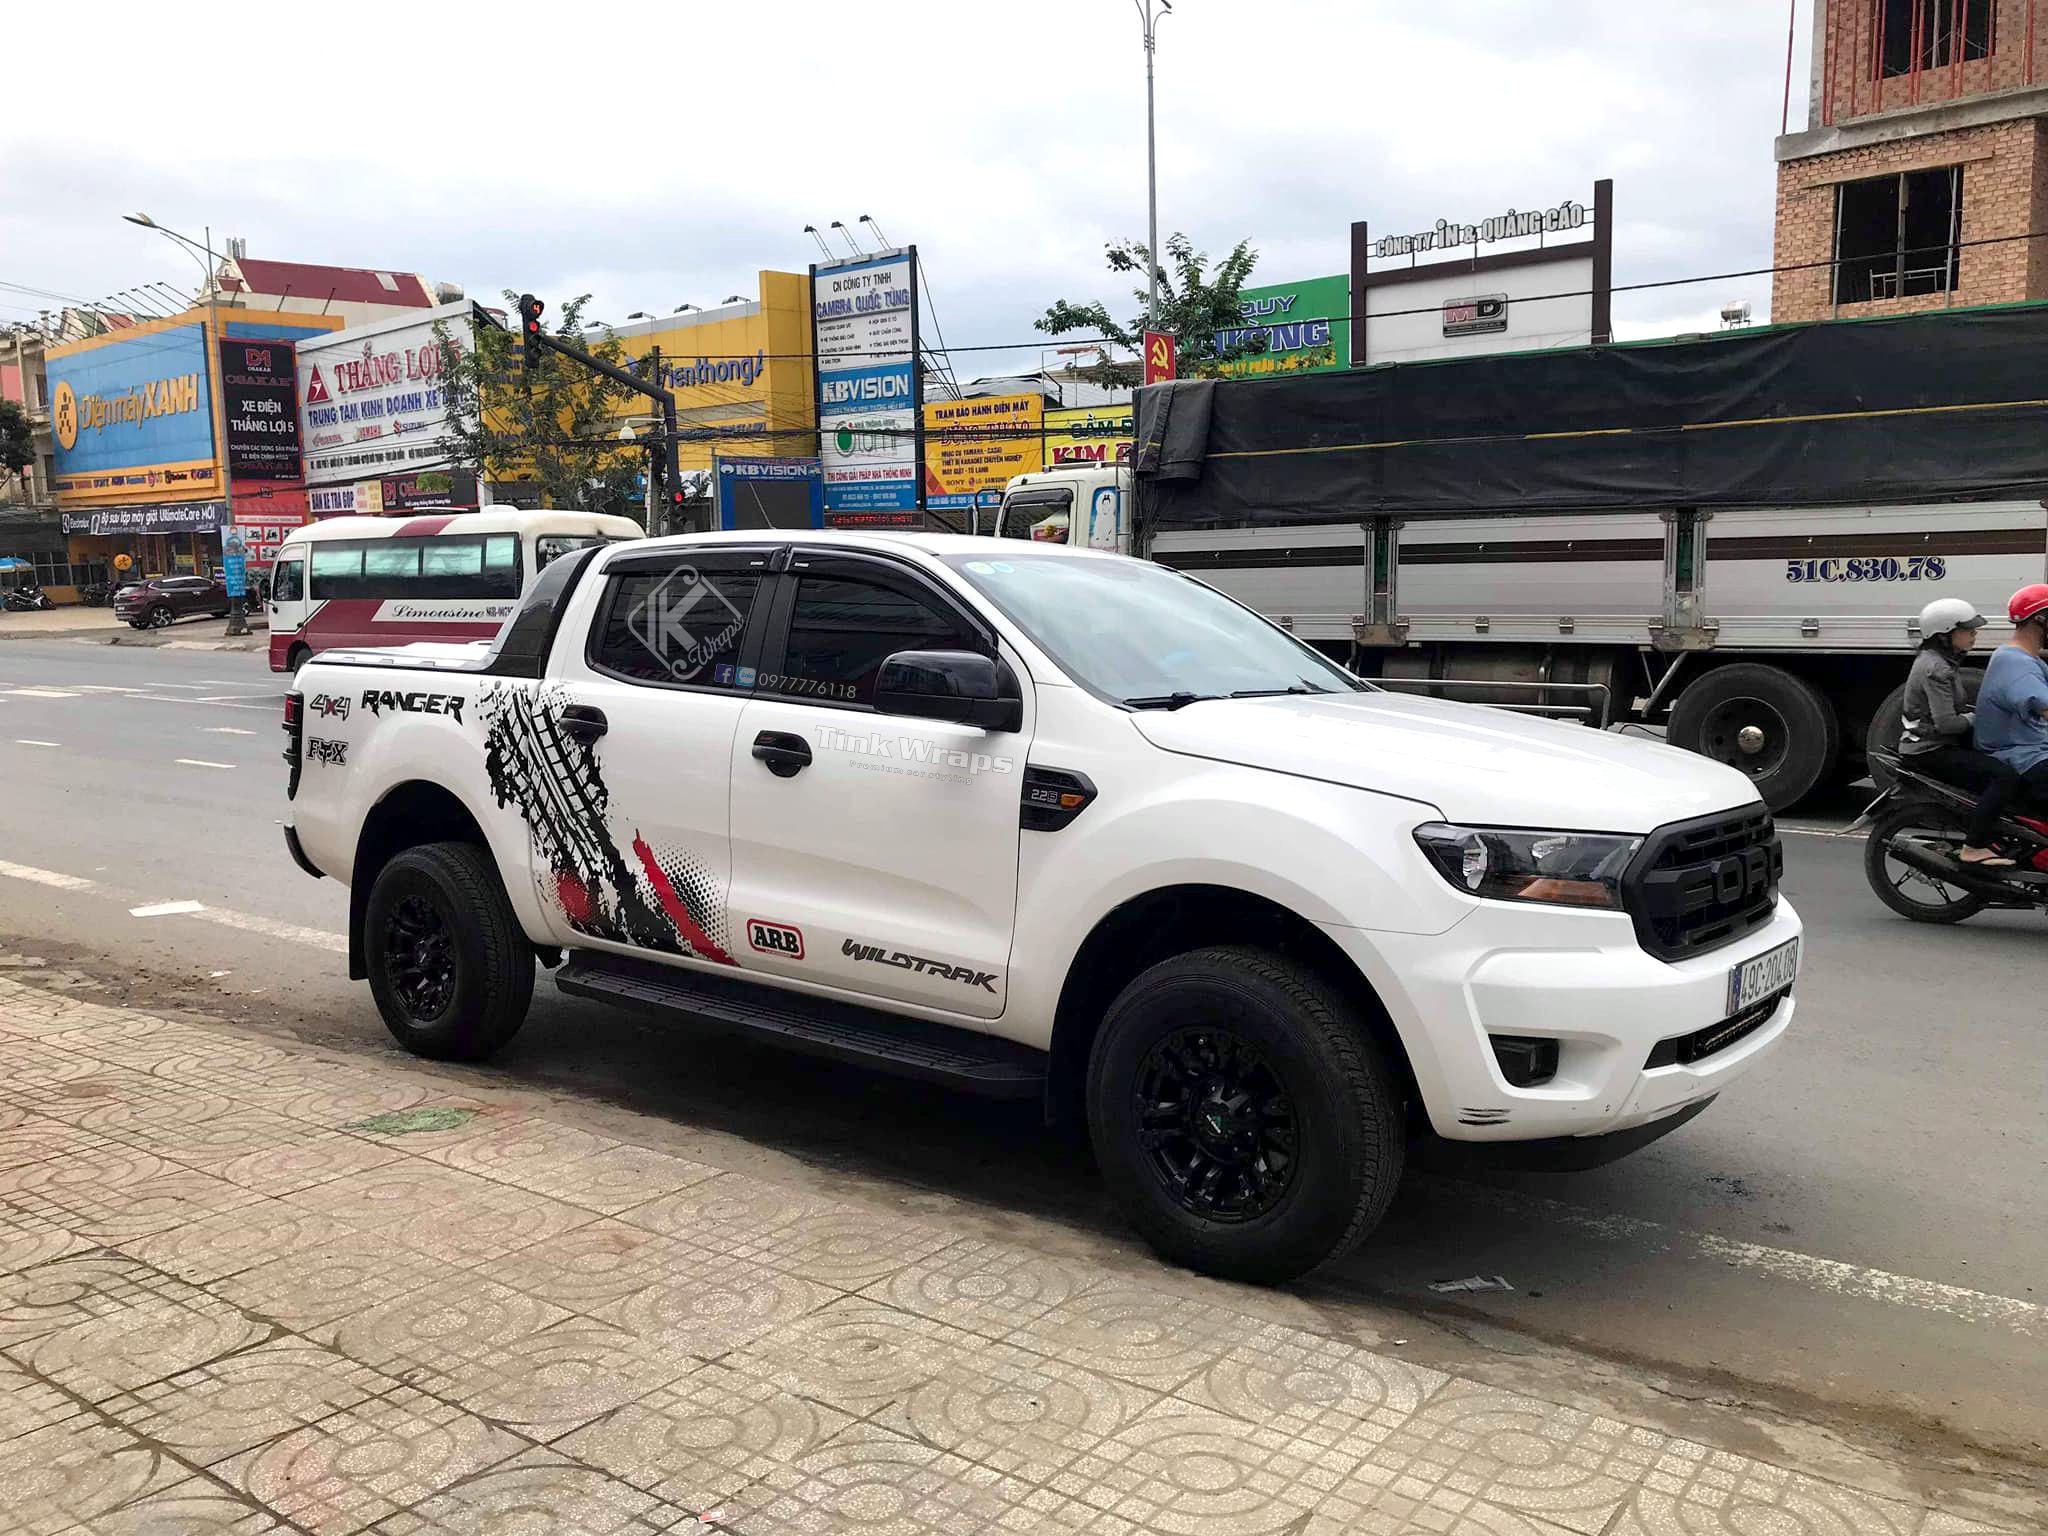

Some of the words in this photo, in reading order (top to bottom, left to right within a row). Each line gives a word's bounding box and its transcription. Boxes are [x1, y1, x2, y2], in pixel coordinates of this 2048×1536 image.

[1376, 235, 1413, 258] CÔNG
[1414, 232, 1433, 251] TY
[1463, 225, 1476, 244] &
[1481, 209, 1542, 243] QUẢNG
[1544, 201, 1585, 232] CÁO
[833, 281, 841, 292] CN
[843, 277, 860, 291] CÔNG
[862, 275, 872, 287] TY
[874, 272, 891, 285] TNHH
[856, 288, 882, 312] QUỐC
[884, 287, 910, 308] TÙNG
[334, 341, 401, 393] THẮNG
[405, 339, 444, 386] LỢI
[145, 373, 199, 418] XANH
[822, 374, 909, 404] KBVISION
[242, 400, 256, 413] XE
[258, 399, 281, 415] ĐIỆN
[309, 407, 337, 428] TRUNG
[340, 401, 358, 422] TÂM
[361, 399, 384, 418] KINH
[386, 392, 422, 415] DOANH
[425, 389, 439, 407] XE
[231, 415, 267, 432] THẮNG
[270, 420, 286, 435] LỢI
[288, 422, 294, 432] 5
[1052, 444, 1106, 464] KIM
[736, 465, 807, 475] KBVISION
[101, 512, 108, 527] Bộ
[109, 513, 119, 524] sưu
[131, 509, 144, 525] máy
[146, 509, 157, 526] giặt
[159, 506, 200, 522] UltimateCare
[1785, 556, 1946, 583] 51C.830.78
[392, 605, 484, 618] Limousine
[688, 617, 745, 667] Wraps
[758, 672, 857, 699] 0977776118
[362, 690, 465, 726] RANGER
[815, 724, 893, 758] Tink
[899, 736, 1013, 775] Wraps
[849, 759, 904, 775] premium
[754, 925, 799, 954] ARB
[841, 938, 999, 994] WILDTRAK
